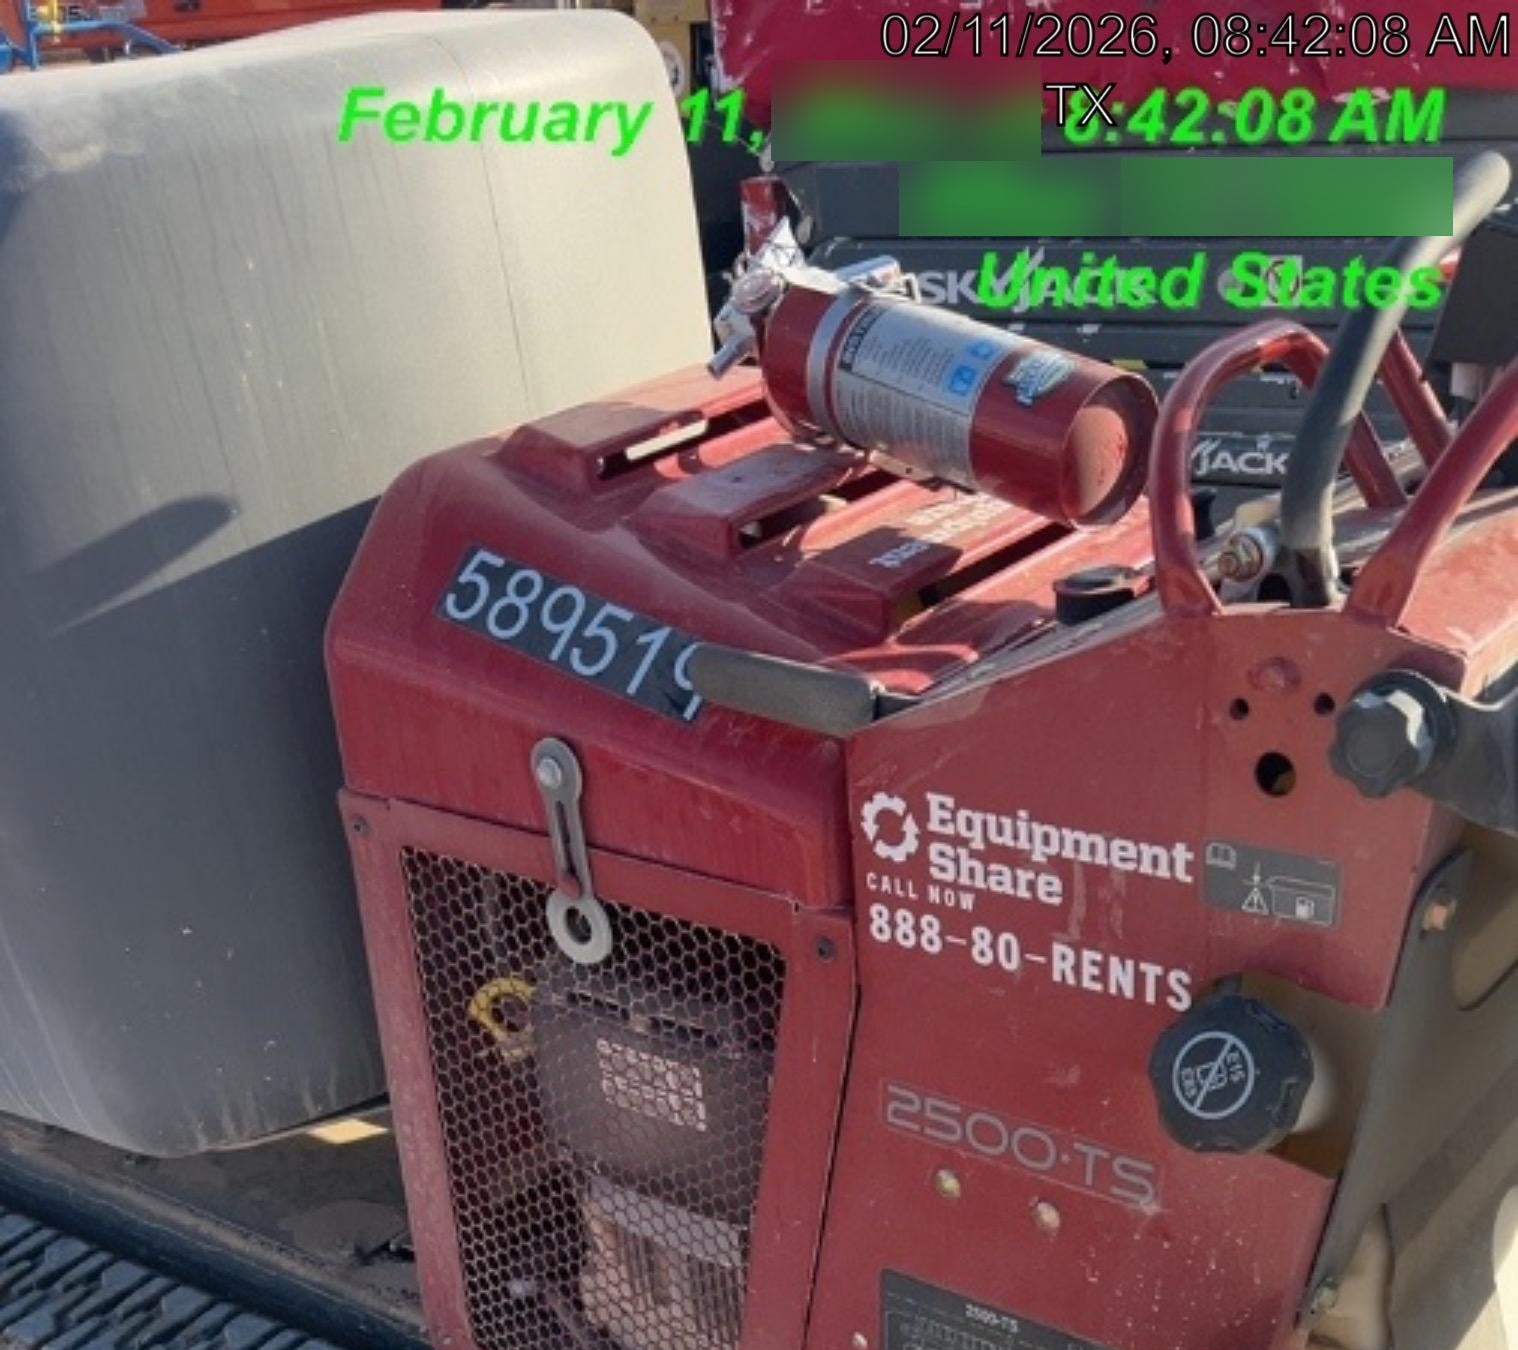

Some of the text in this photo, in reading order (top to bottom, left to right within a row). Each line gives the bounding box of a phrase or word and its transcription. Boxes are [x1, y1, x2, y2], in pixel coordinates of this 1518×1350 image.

[926, 792, 1194, 883] Equipment
[928, 841, 1063, 905] Share
[866, 872, 975, 912] CALL NOW
[869, 903, 1192, 1012] 888-80-RENTS
